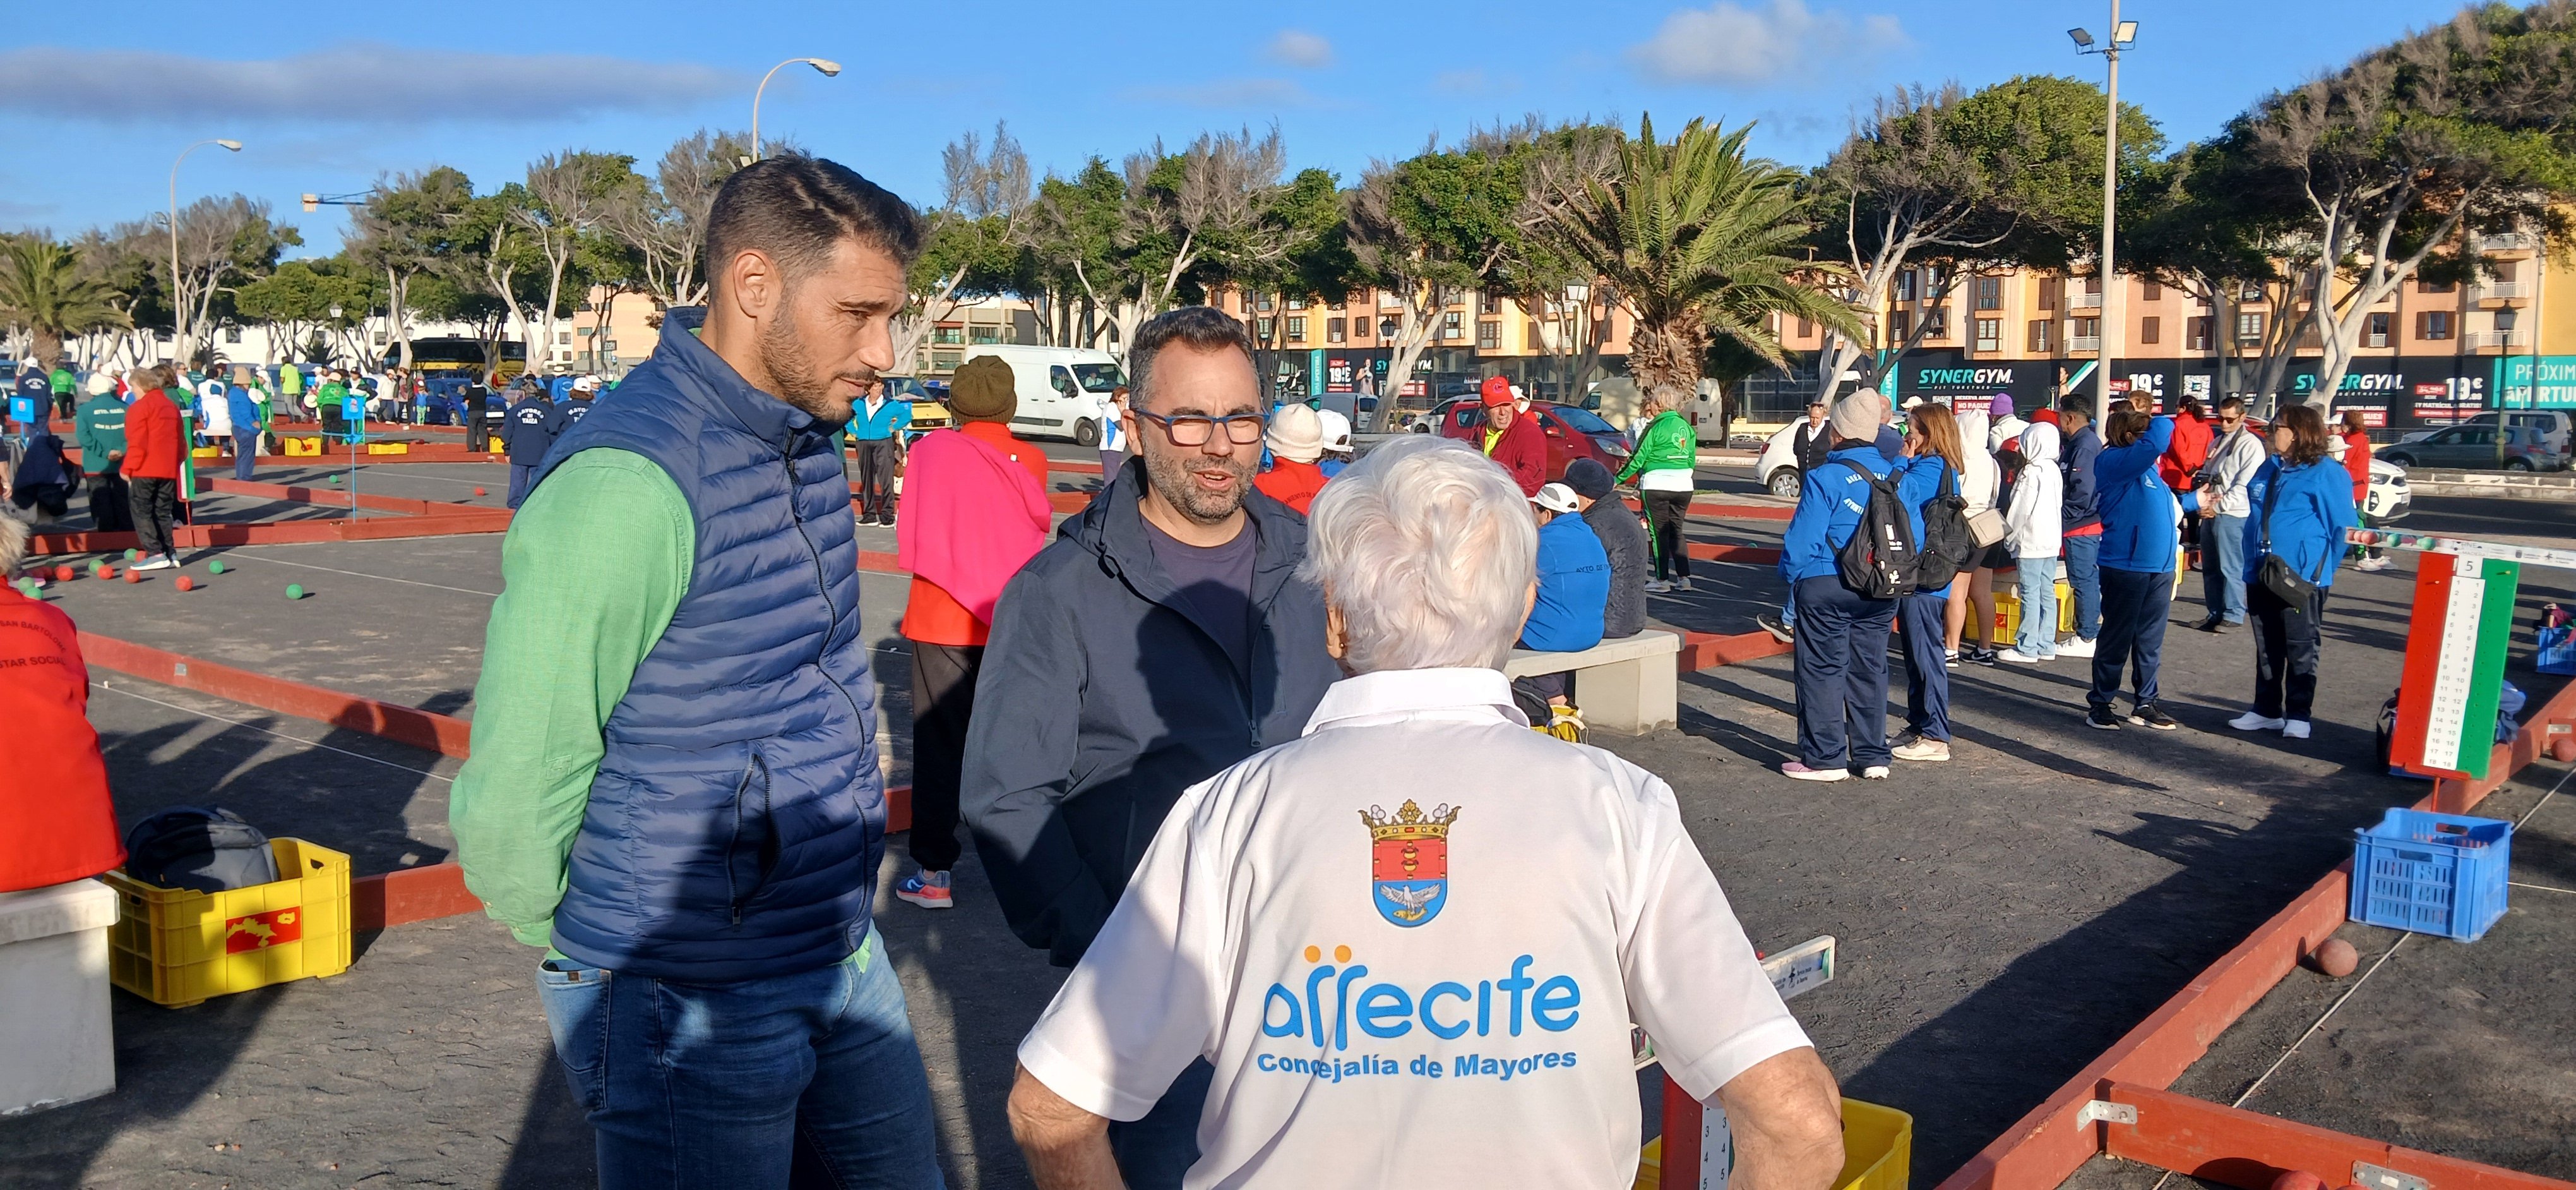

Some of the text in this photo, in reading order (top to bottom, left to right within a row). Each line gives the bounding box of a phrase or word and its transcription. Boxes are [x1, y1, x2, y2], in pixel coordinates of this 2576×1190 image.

[2465, 560, 2474, 572] 5
[1263, 945, 1581, 1051] arrecife
[1257, 1050, 1577, 1083] Concejalía de Mayores
[1705, 1117, 1727, 1138] 3 3
[1703, 1143, 1726, 1163] 4 4
[1703, 1168, 1725, 1190] 5 5
